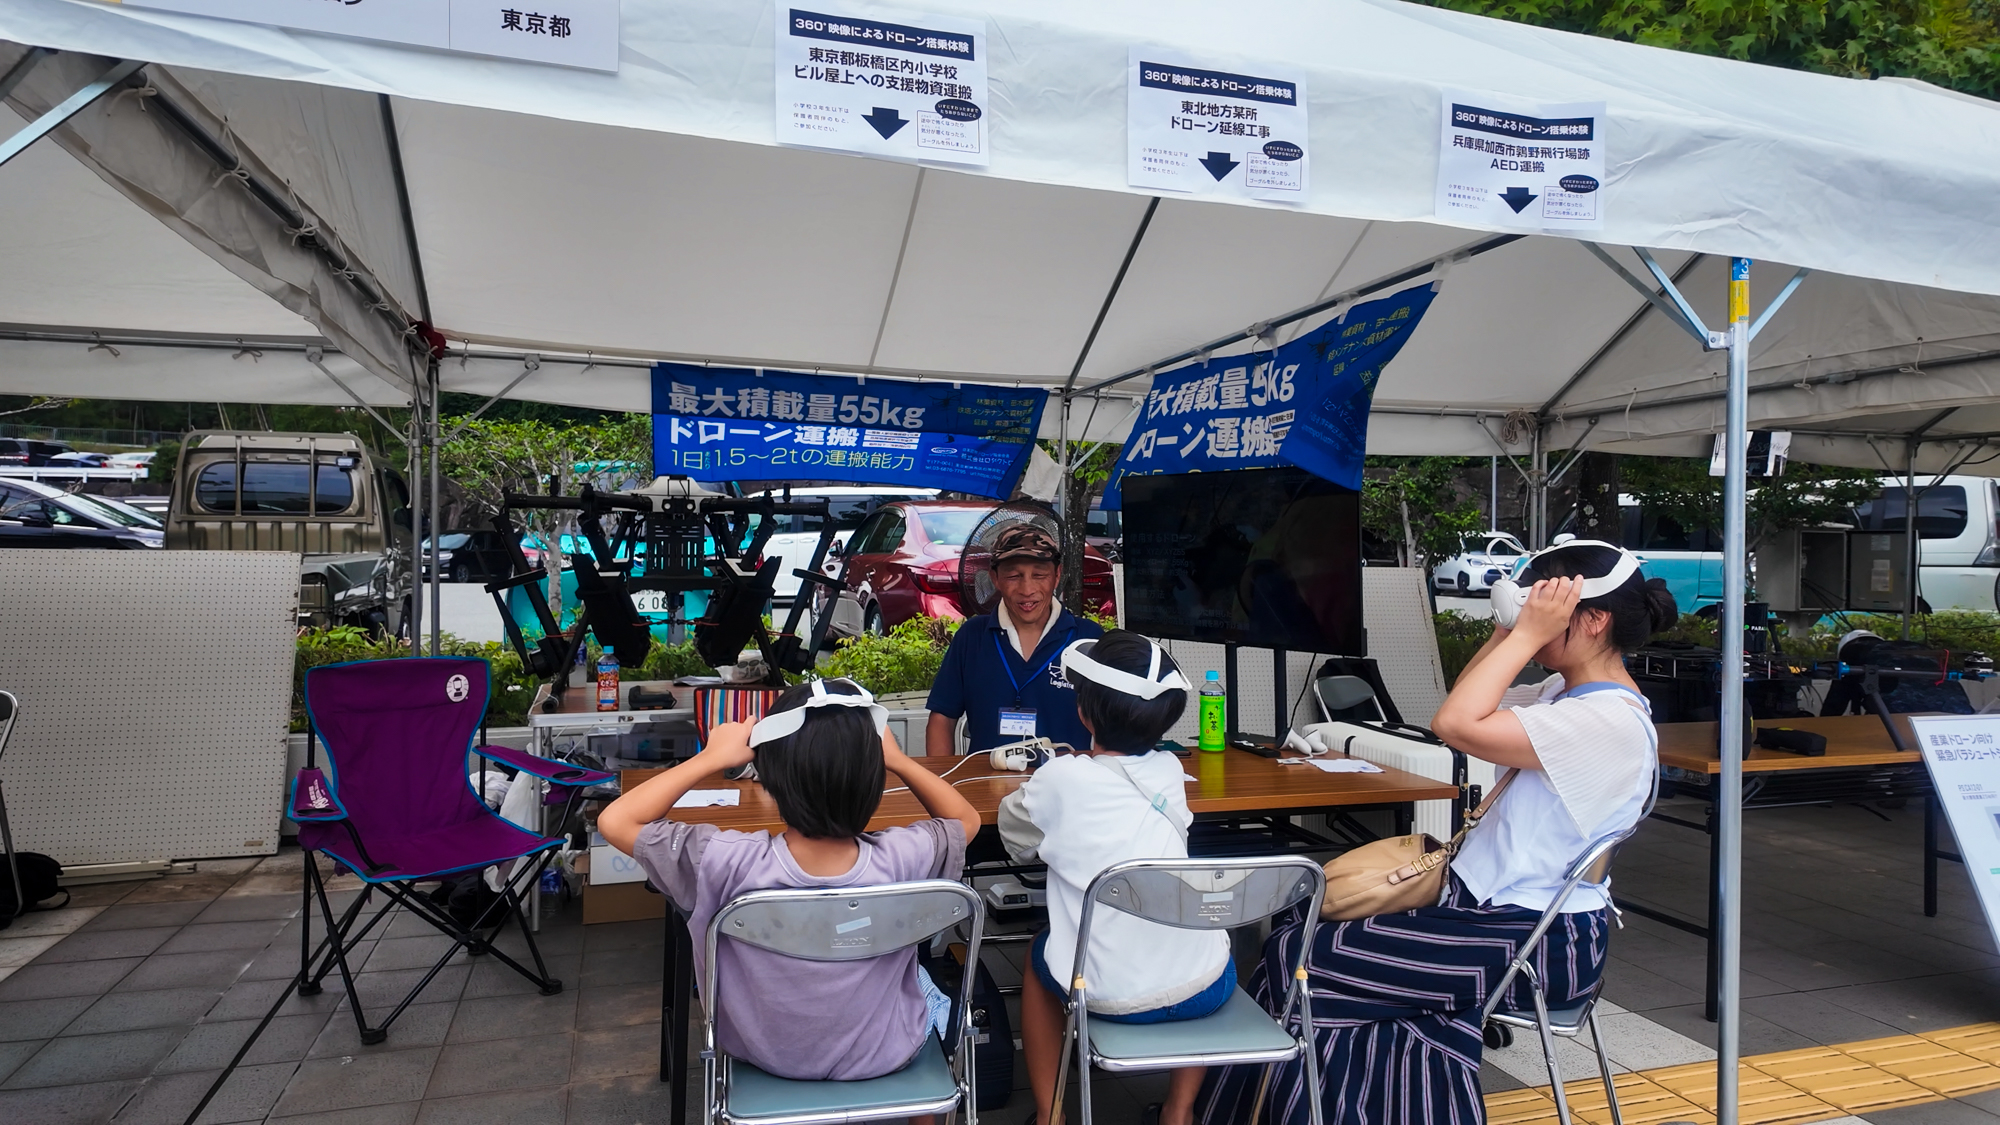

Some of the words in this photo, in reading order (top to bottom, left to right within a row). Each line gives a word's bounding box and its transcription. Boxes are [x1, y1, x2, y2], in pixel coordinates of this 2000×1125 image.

[501, 9, 571, 38] 東京都
[808, 47, 958, 80] 東京都板橋区内小学校
[794, 64, 972, 100] ビル屋上への支援物資運搬
[1181, 100, 1258, 121] 東北地方某所
[1171, 115, 1271, 138] ドローン延線工事
[1490, 158, 1545, 173] AED運搬
[668, 381, 926, 429] 最大積載量55kg
[671, 418, 860, 447] ドローン運搬
[1929, 733, 1993, 746] 産業ドローン向け
